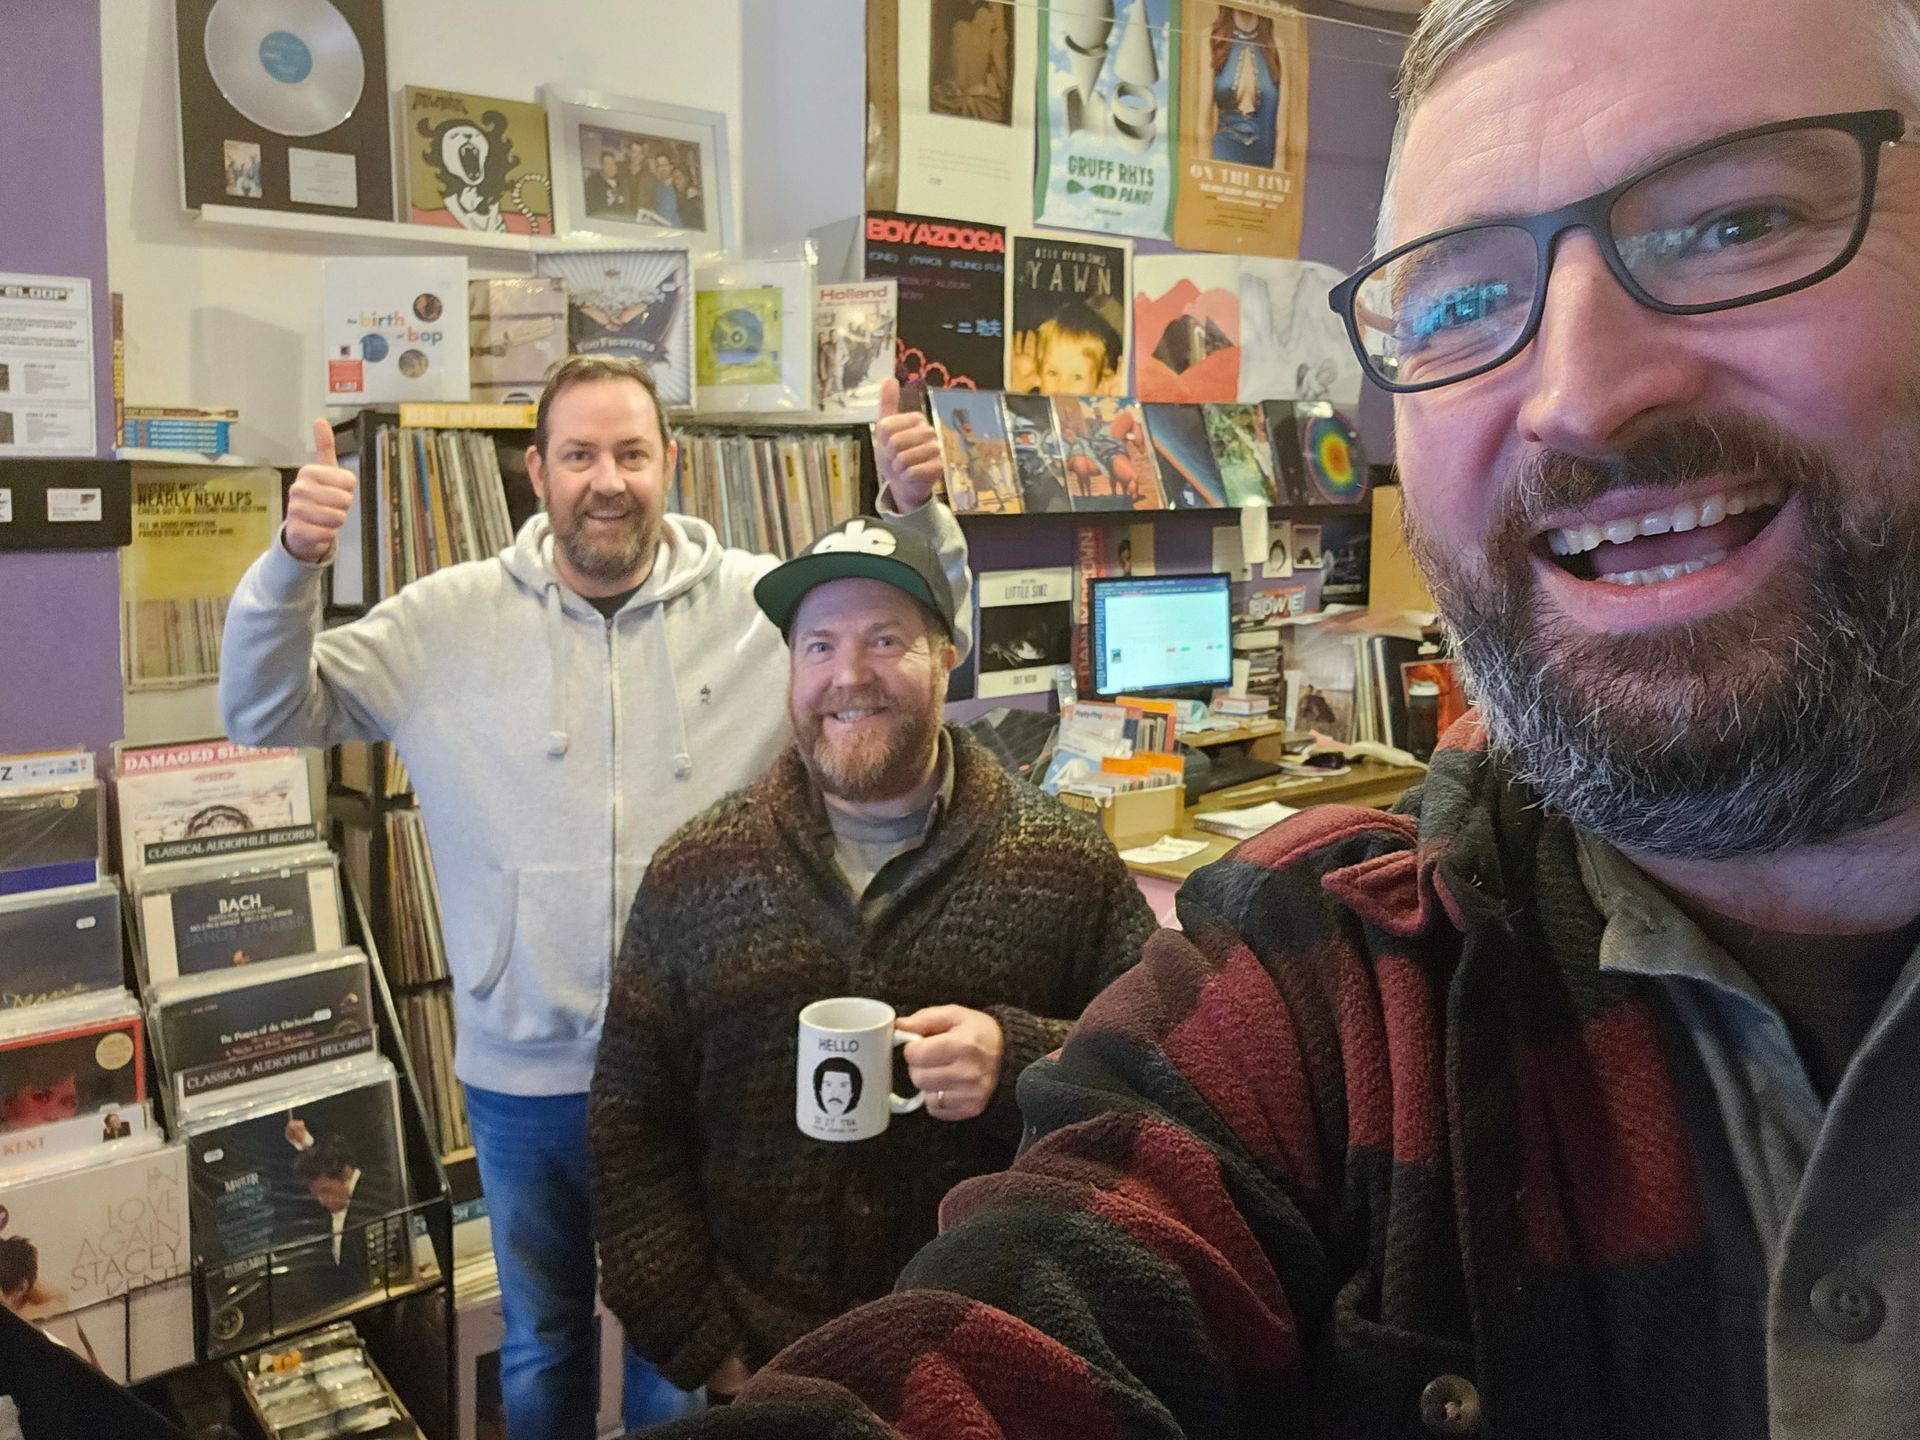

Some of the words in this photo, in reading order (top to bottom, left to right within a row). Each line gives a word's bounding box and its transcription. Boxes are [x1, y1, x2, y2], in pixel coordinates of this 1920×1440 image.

[1068, 155, 1115, 181] GRUFF
[1118, 163, 1155, 187] RHYS
[1025, 259, 1112, 296] YAWN
[820, 286, 888, 302] Holland
[360, 311, 405, 328] birth
[406, 326, 444, 347] bop
[137, 491, 193, 508] NEARLY
[194, 491, 226, 507] NEW
[229, 491, 253, 506] LPS
[1004, 585, 1031, 601] LITTLE
[125, 746, 215, 772] DAMAGED
[148, 843, 204, 860] CLASSICAL
[207, 835, 268, 854] AUDIOPHILE
[269, 828, 316, 846] RECORDS
[218, 893, 263, 915] BACH
[819, 1038, 860, 1054] HELLO
[186, 1065, 250, 1091] CLASSICAL
[252, 1050, 319, 1075] AUDIOPHILE
[320, 1036, 371, 1057] RECORDS
[3, 1136, 45, 1157] KENT
[147, 1160, 180, 1193] IN
[108, 1190, 181, 1230] LOVE
[76, 1212, 181, 1267] AGAIN
[71, 1236, 183, 1293] STACEY
[106, 1261, 185, 1298] KENT
